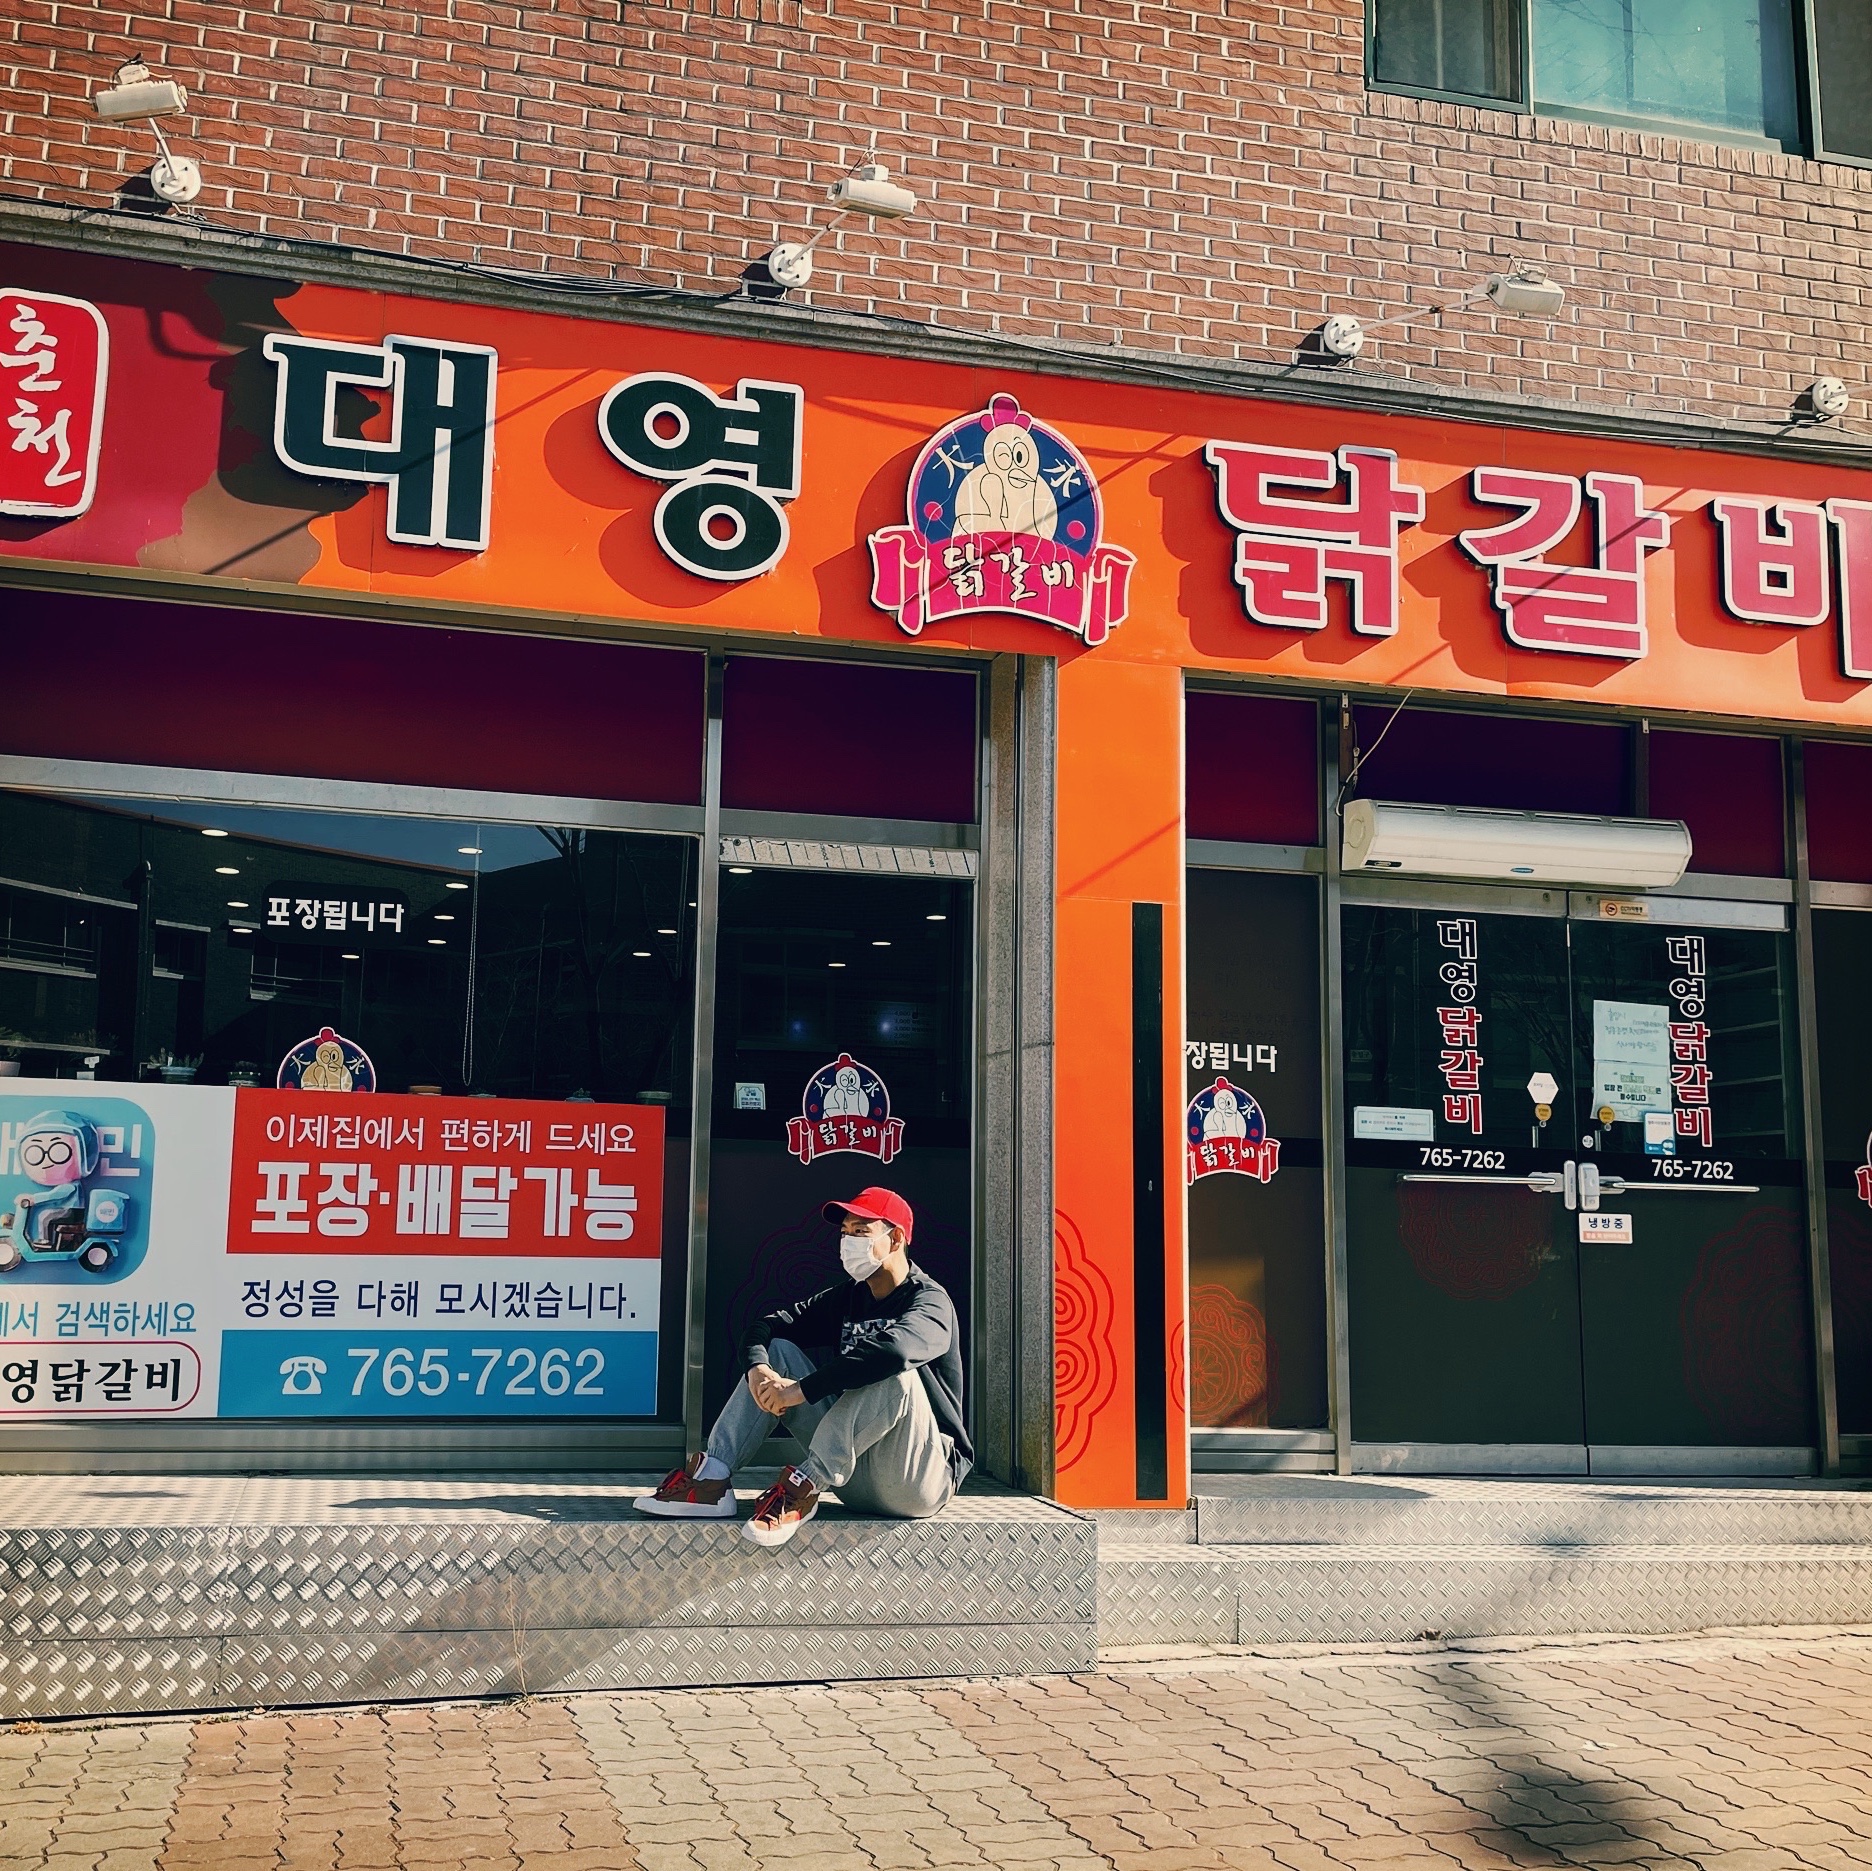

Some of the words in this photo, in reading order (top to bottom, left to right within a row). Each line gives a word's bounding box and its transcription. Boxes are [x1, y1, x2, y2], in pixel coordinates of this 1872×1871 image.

[0, 304, 82, 487] 춘천
[263, 333, 805, 581] 대영
[1206, 439, 1872, 678] 닭갈비
[944, 543, 1075, 601] 닭갈비
[267, 896, 405, 933] 포장됩니다
[1437, 919, 1483, 1134] 대영닭갈비
[1666, 936, 1713, 1147] 대영닭갈비
[1185, 1041, 1278, 1073] 장됩니다
[266, 1114, 425, 1151] 이제집에서
[440, 1118, 532, 1153] 편하게
[545, 1123, 637, 1156] 드세요
[819, 1121, 877, 1146] 닭갈비
[1200, 1143, 1255, 1167] 닭갈비
[1420, 1147, 1505, 1170] 765-7262
[1651, 1159, 1734, 1180] 765-7262
[55, 1301, 197, 1337] 검색하세요
[241, 1279, 340, 1318] 정성을
[357, 1280, 419, 1318] 다해
[435, 1281, 637, 1319] 모시겠습니다.
[2, 1358, 181, 1404] 영닭갈비
[347, 1347, 605, 1397] 765-7262
